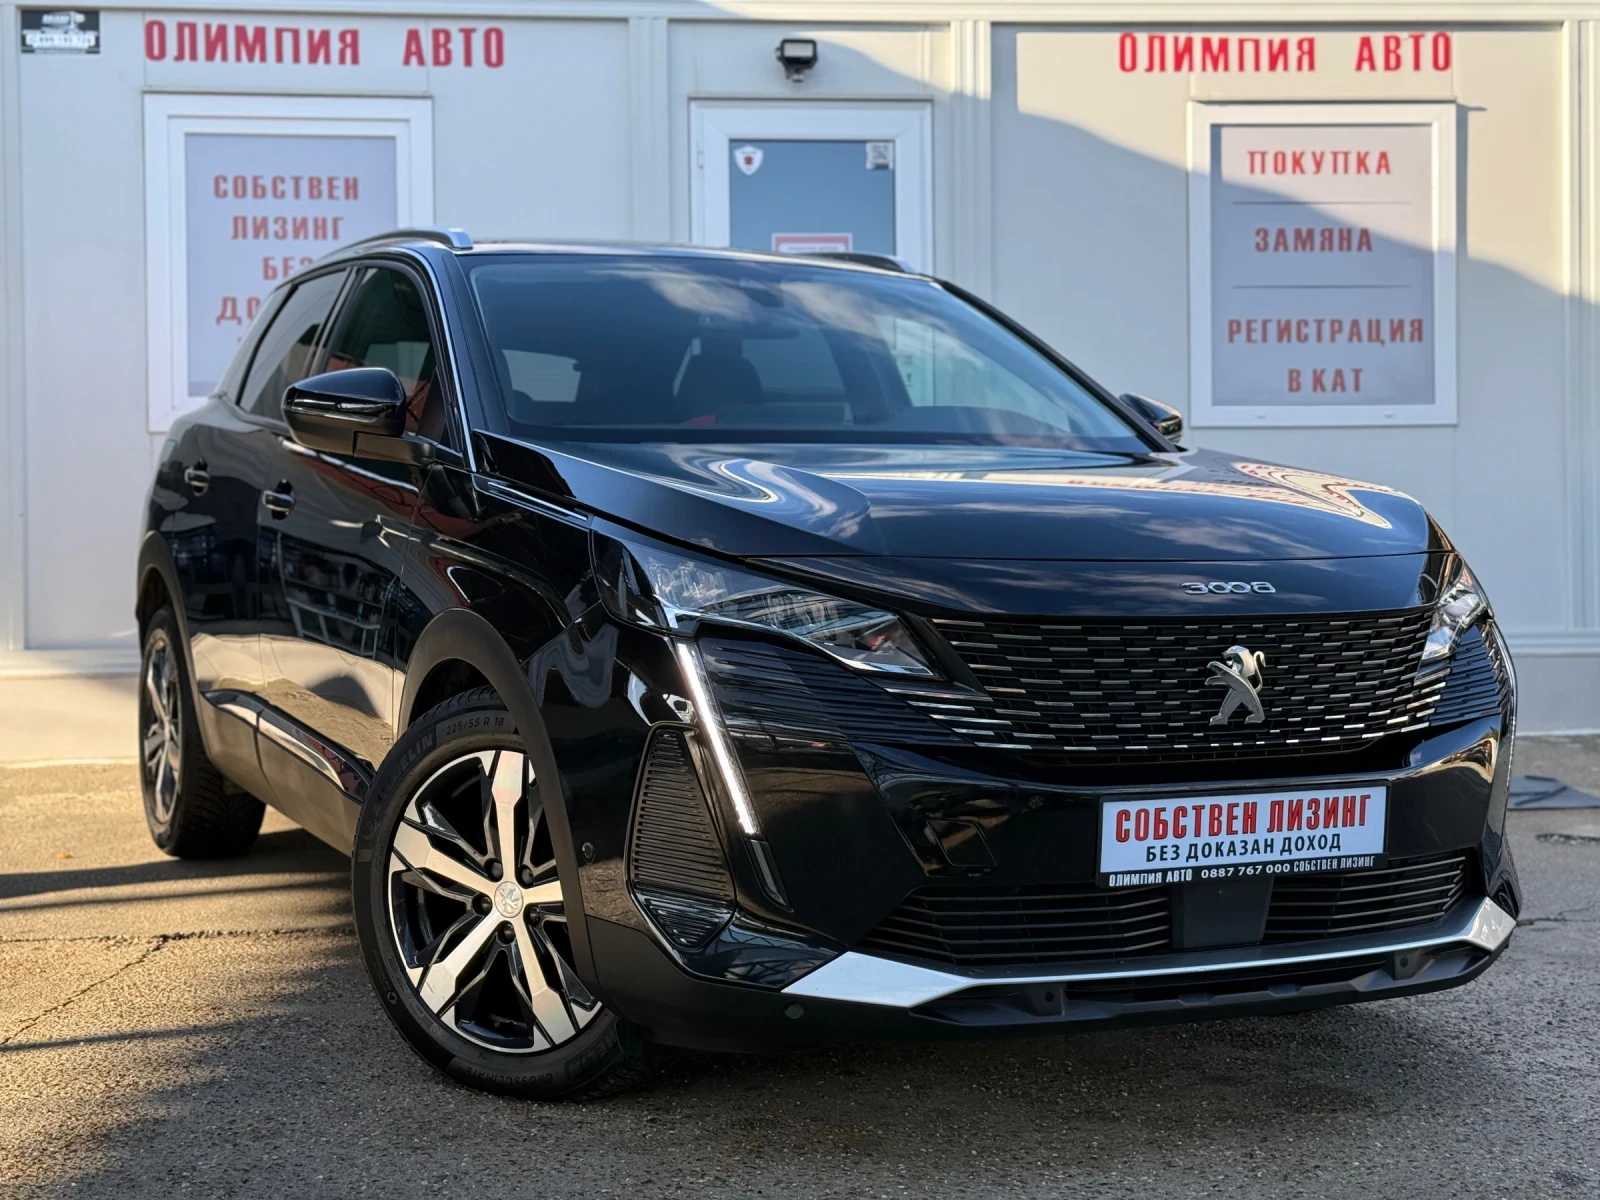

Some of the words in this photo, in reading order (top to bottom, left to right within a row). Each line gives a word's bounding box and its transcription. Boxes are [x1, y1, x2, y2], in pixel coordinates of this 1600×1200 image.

[144, 20, 360, 66] ОЛИМПИЯ
[402, 27, 505, 69] АВТО
[1118, 32, 1316, 73] ОЛИМПИЯ
[1354, 31, 1453, 73] АВТО
[1247, 150, 1392, 175] ПОКУПКА
[213, 174, 359, 201] СОБСТВЕН
[231, 215, 344, 241] ЛИЗИНГ
[1254, 227, 1373, 253] ЗАМЯНА
[1227, 318, 1424, 346] РЕГИСТРАЦИЯ
[1287, 368, 1302, 393] В
[1312, 368, 1363, 393] КАТ
[1181, 581, 1276, 595] 3008
[446, 718, 480, 736] 225/55
[494, 717, 505, 727] 18
[1115, 801, 1258, 843] СОБСТВЕН
[1266, 794, 1371, 833] ЛИЗИНГ
[1145, 844, 1180, 863] БЕЗ
[1185, 838, 1274, 863] ДОКАЗАН
[1279, 833, 1341, 856] ДОХОД
[1108, 871, 1162, 887] ОЛИМПИЯ
[1166, 868, 1193, 883] АВТО
[1201, 867, 1235, 879] 0887
[1237, 865, 1263, 876] 767
[1265, 863, 1290, 874] 000
[1293, 859, 1338, 872] СОБСТВЕН
[1340, 855, 1375, 869] ЛИЗИНГ
